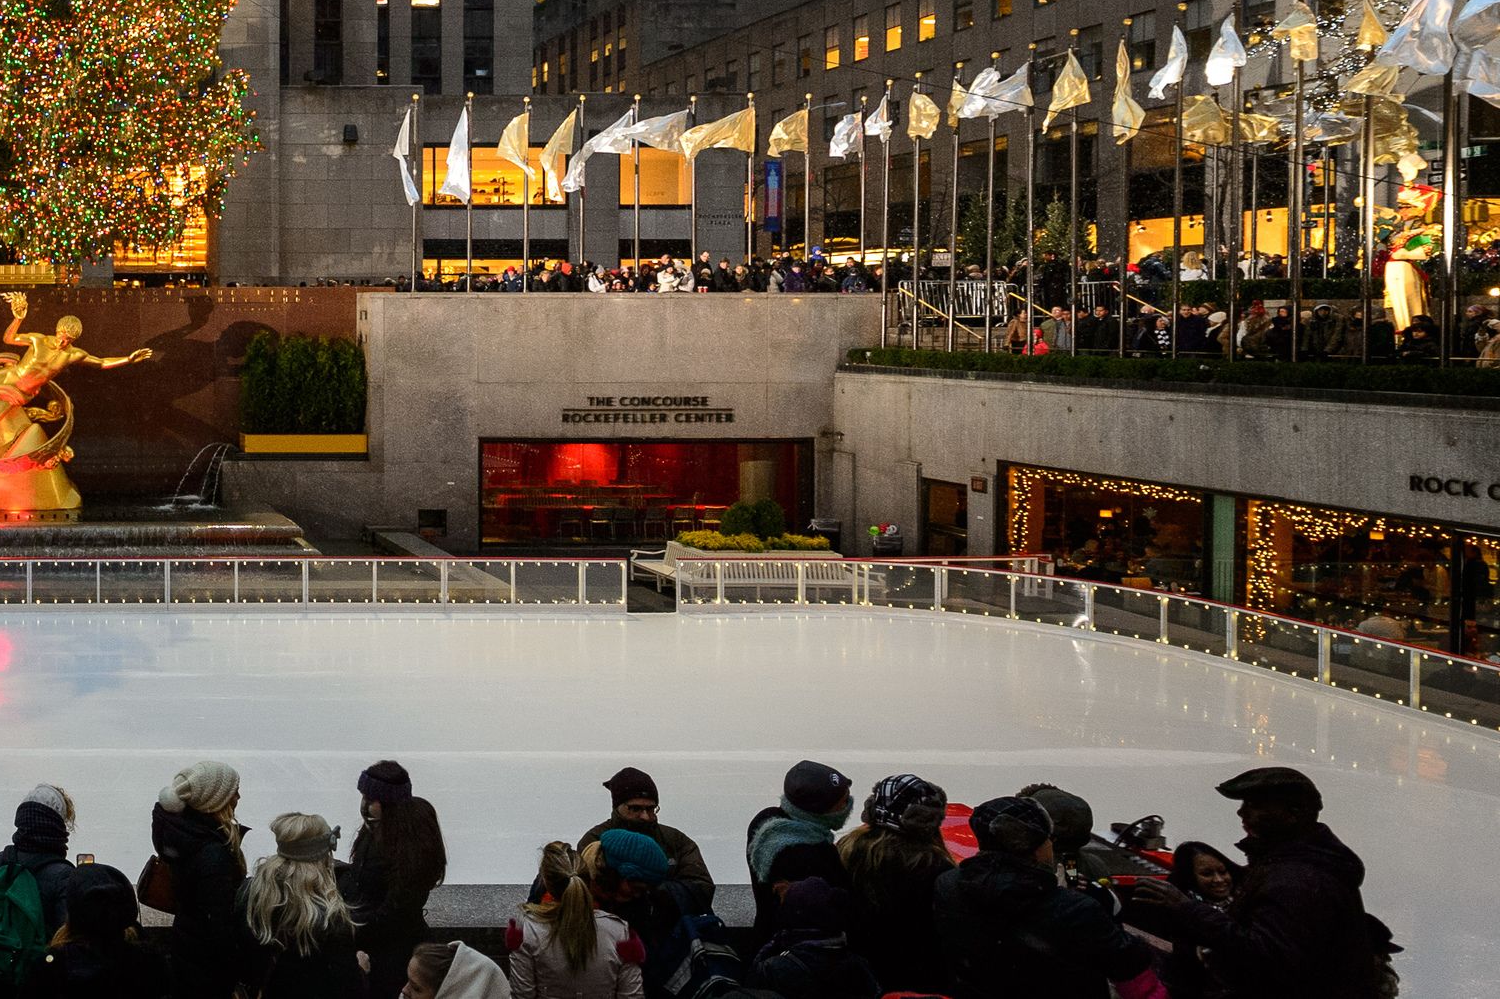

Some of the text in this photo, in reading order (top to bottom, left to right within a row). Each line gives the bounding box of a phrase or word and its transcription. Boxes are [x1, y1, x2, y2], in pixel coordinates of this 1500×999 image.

[587, 396, 710, 407] THE CONCOURSE
[561, 413, 735, 424] ROCKEFELLER CENTER
[1409, 475, 1480, 498] ROCK
